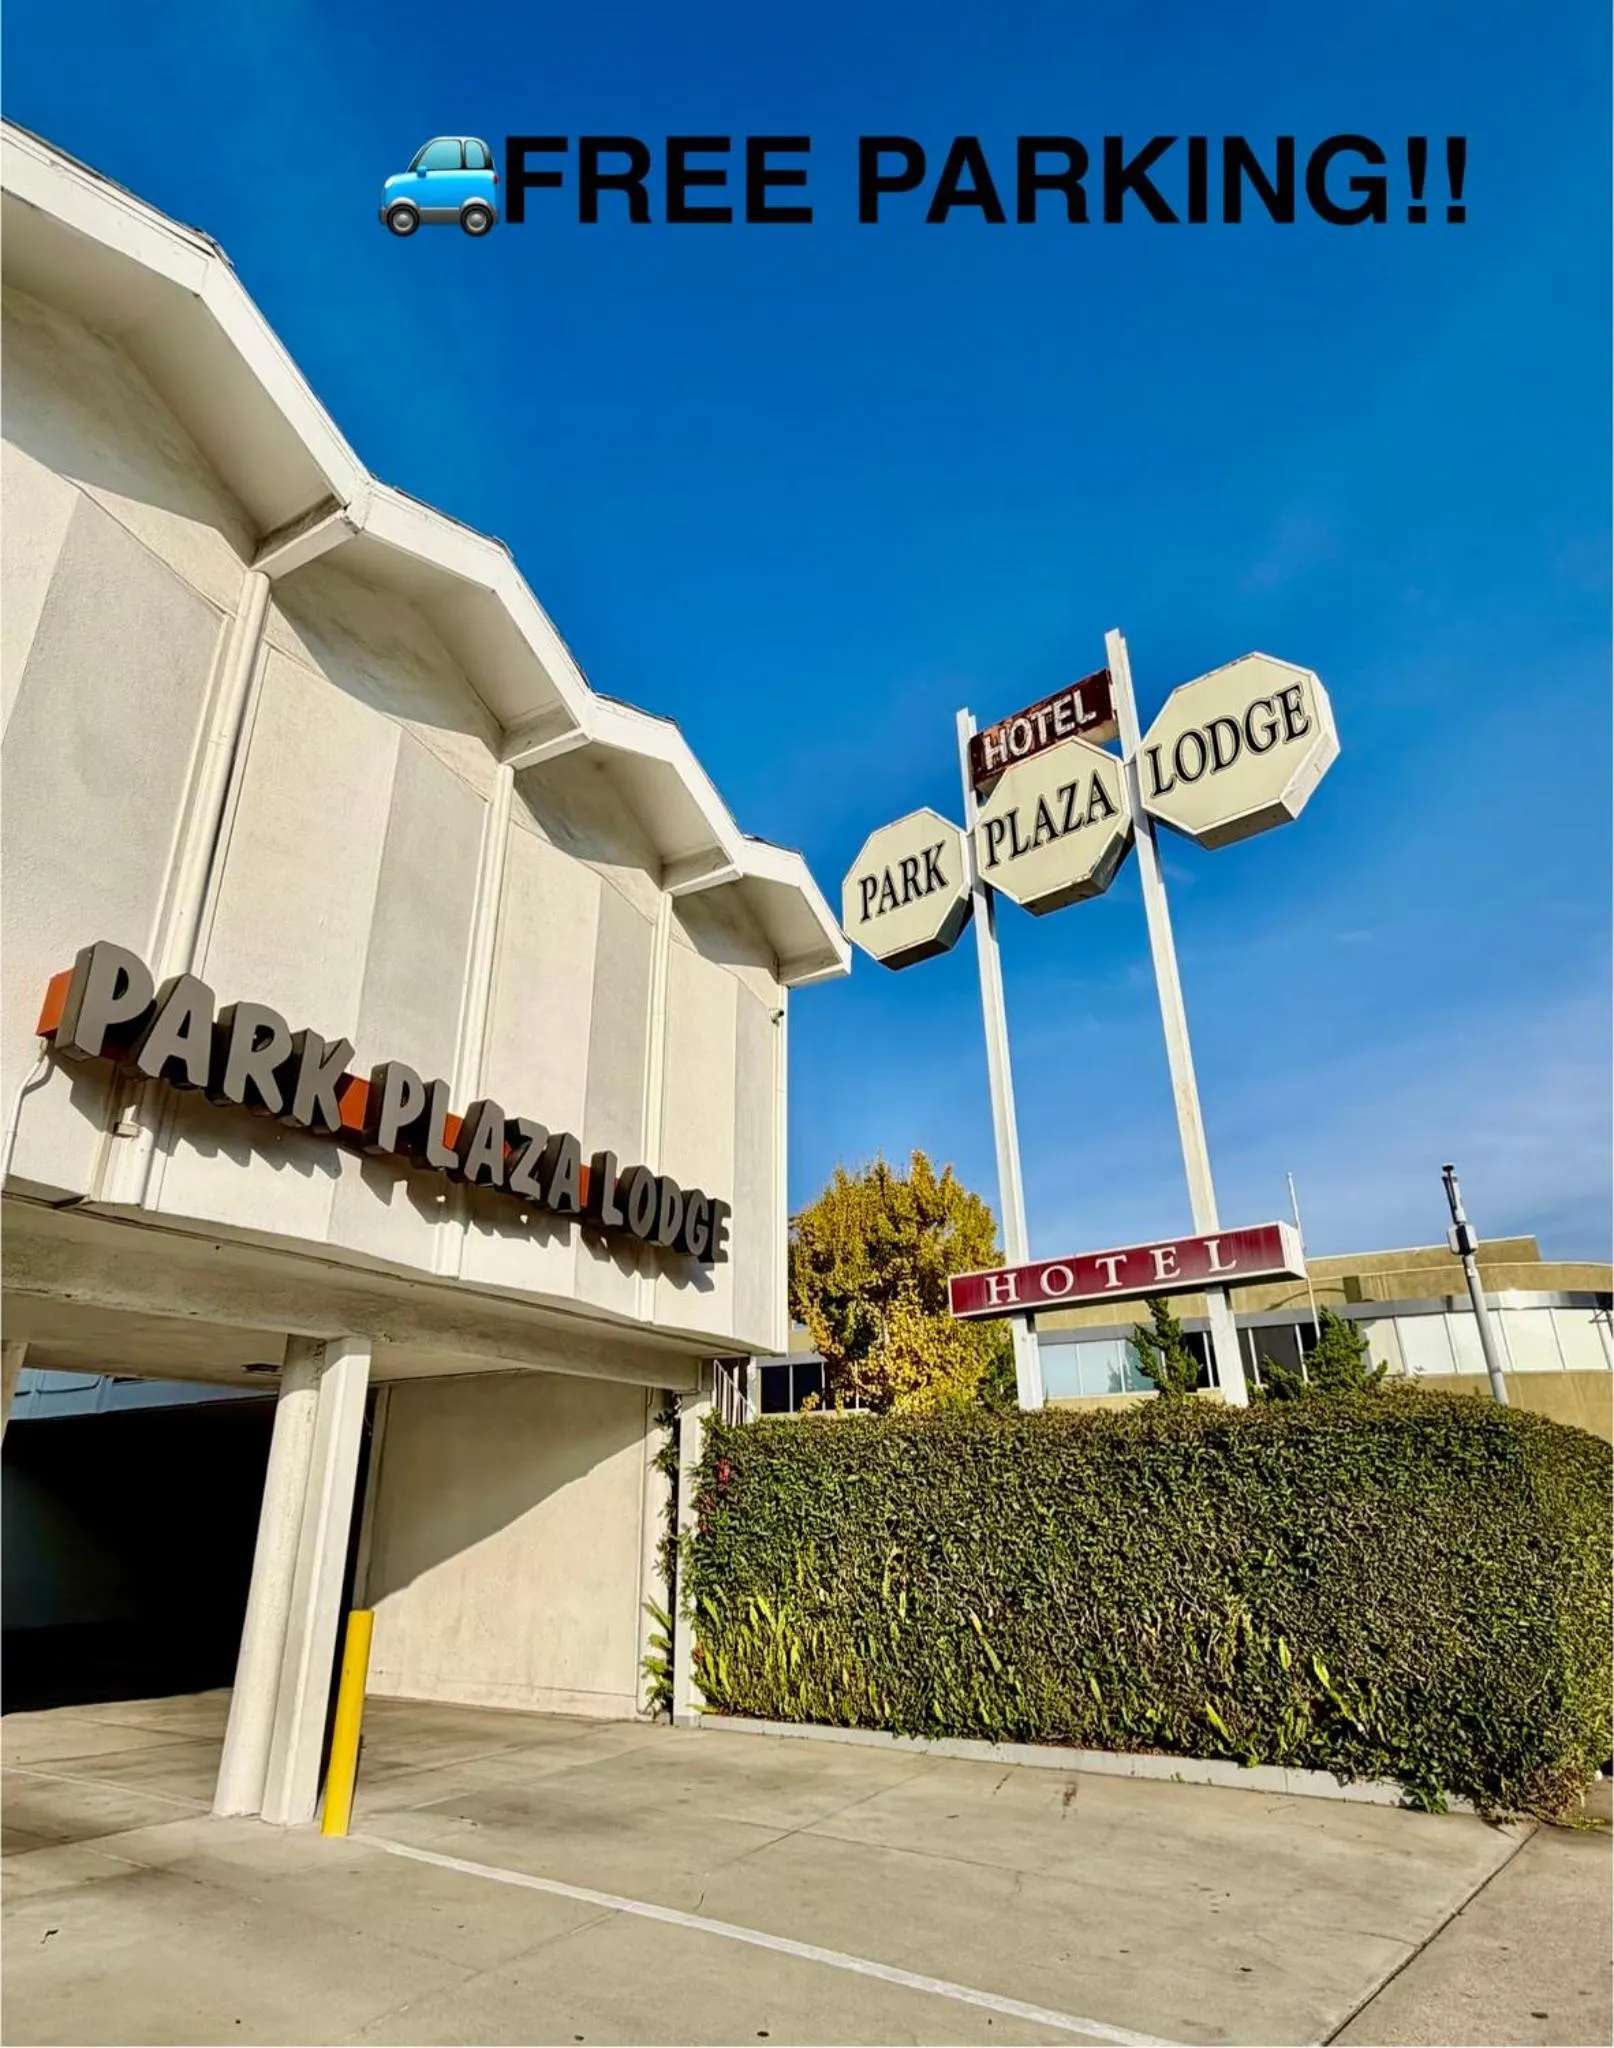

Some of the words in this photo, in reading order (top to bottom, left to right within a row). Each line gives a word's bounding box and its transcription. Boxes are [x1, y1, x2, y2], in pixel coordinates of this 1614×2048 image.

[858, 840, 949, 923] PARK
[981, 769, 1118, 870] PLAZA
[1144, 682, 1310, 798] LODGE
[981, 689, 1097, 772] HOTEL
[58, 941, 355, 1132] PARK
[366, 1060, 581, 1214] PLAZA
[591, 1151, 732, 1263] LODGE
[986, 1239, 1237, 1305] HOTEL
